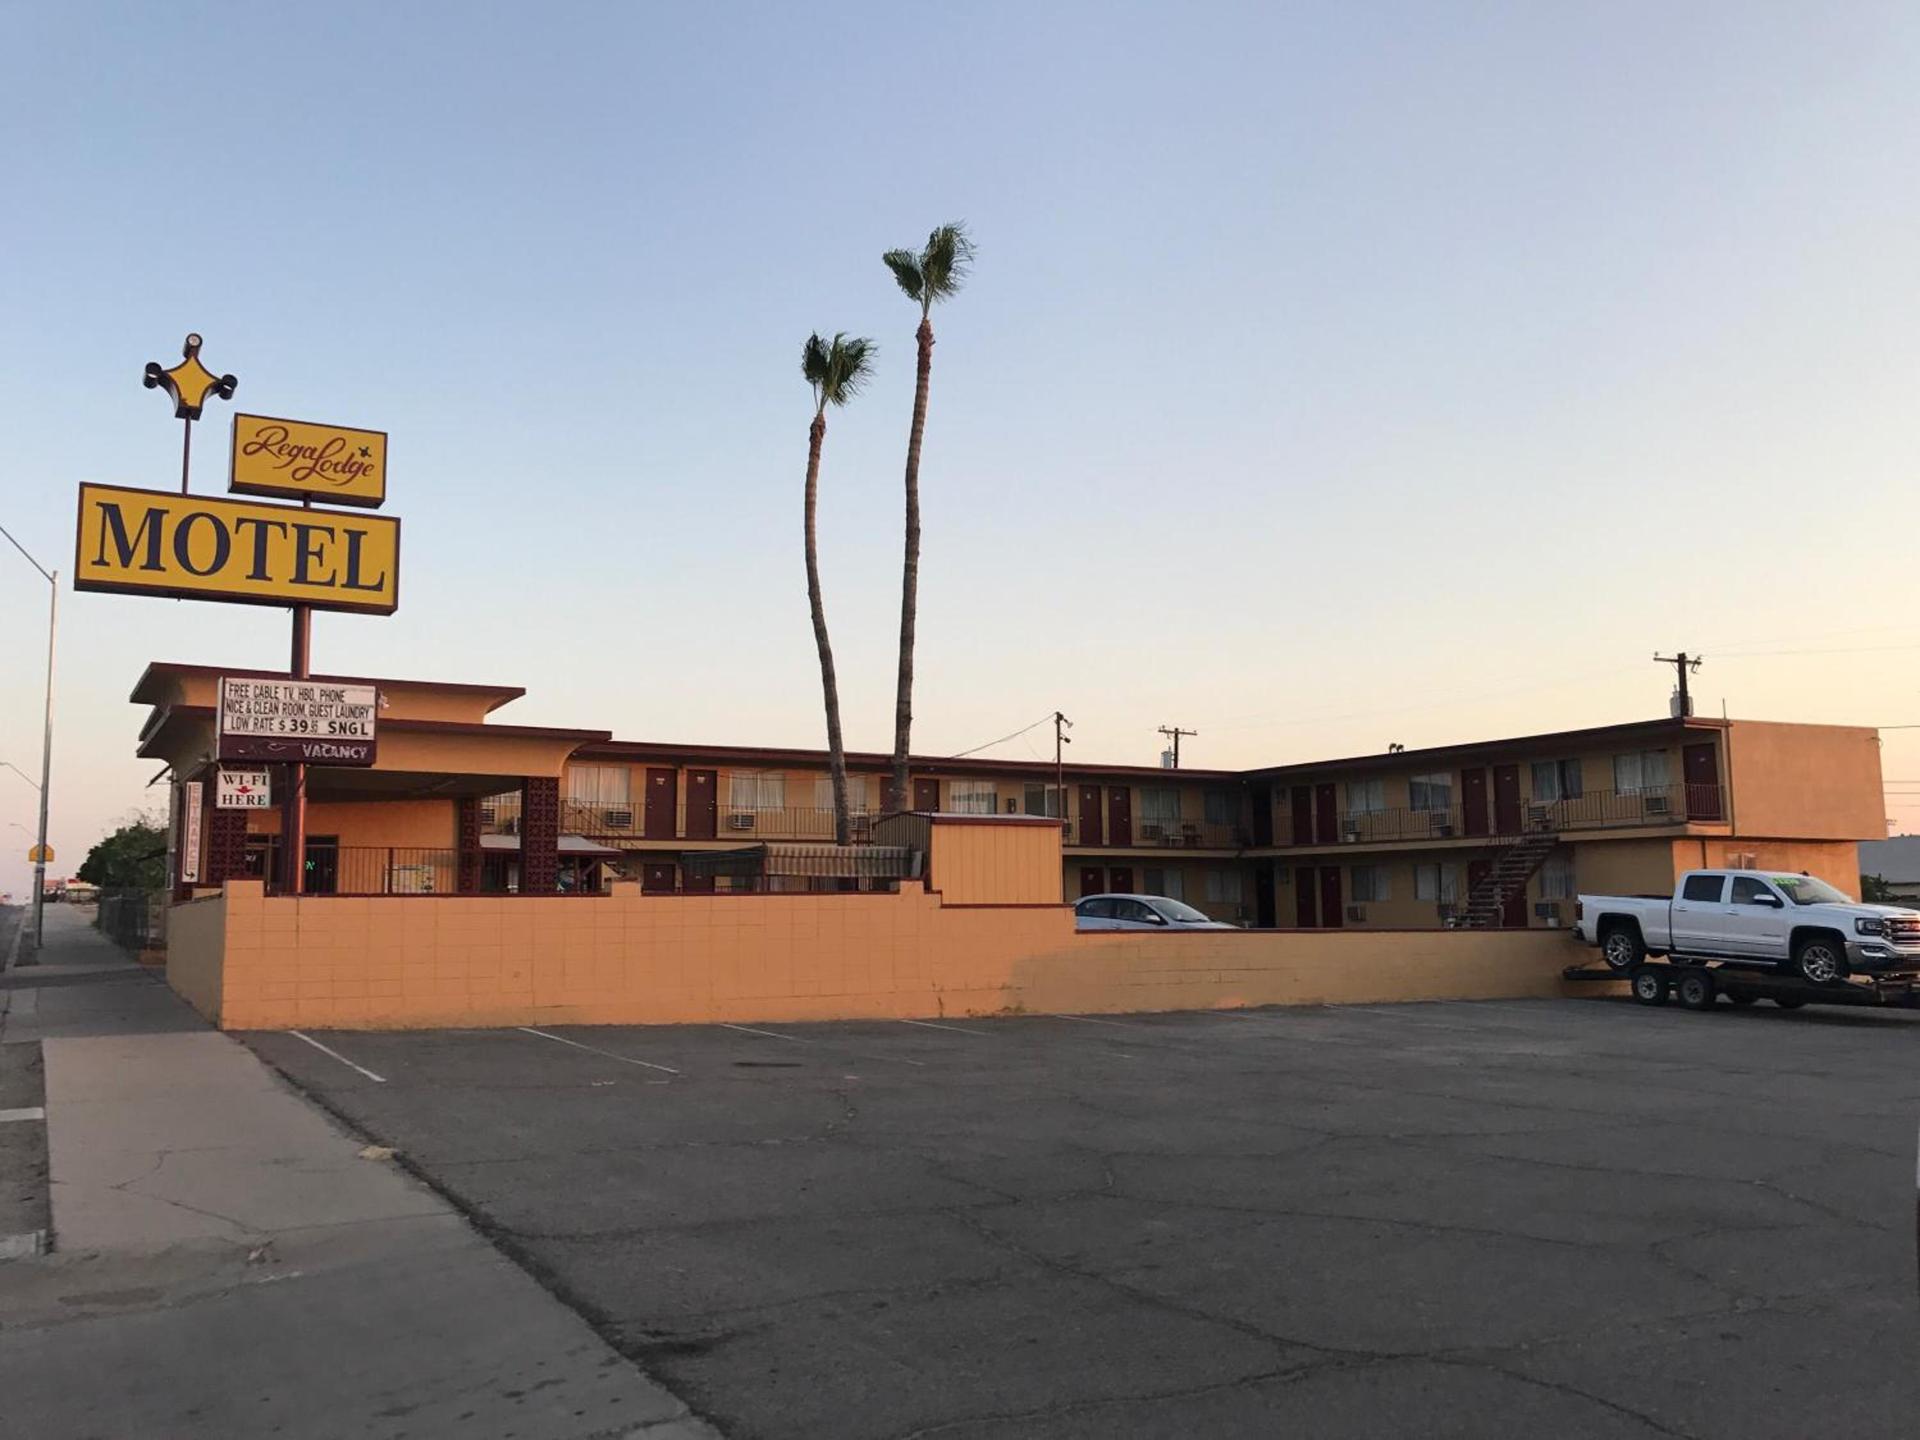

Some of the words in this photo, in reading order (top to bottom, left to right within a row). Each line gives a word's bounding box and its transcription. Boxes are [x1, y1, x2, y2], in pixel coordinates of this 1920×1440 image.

[91, 501, 385, 592] MOTEL
[229, 683, 250, 698] FREE
[254, 685, 279, 700] CABLE
[319, 689, 345, 703] PHONE
[226, 700, 244, 714] NICE
[246, 701, 251, 714] &
[253, 701, 279, 715] CLEAN
[309, 704, 333, 718] GUEST
[335, 705, 369, 719] LAUNDRY
[231, 716, 249, 730] LOW
[253, 717, 274, 732] RATE
[328, 721, 369, 736] SNGL
[302, 743, 368, 759] VACANCY
[222, 774, 267, 786] WI-FI
[222, 794, 266, 806] HERE
[189, 784, 200, 870] ENTRANCE
